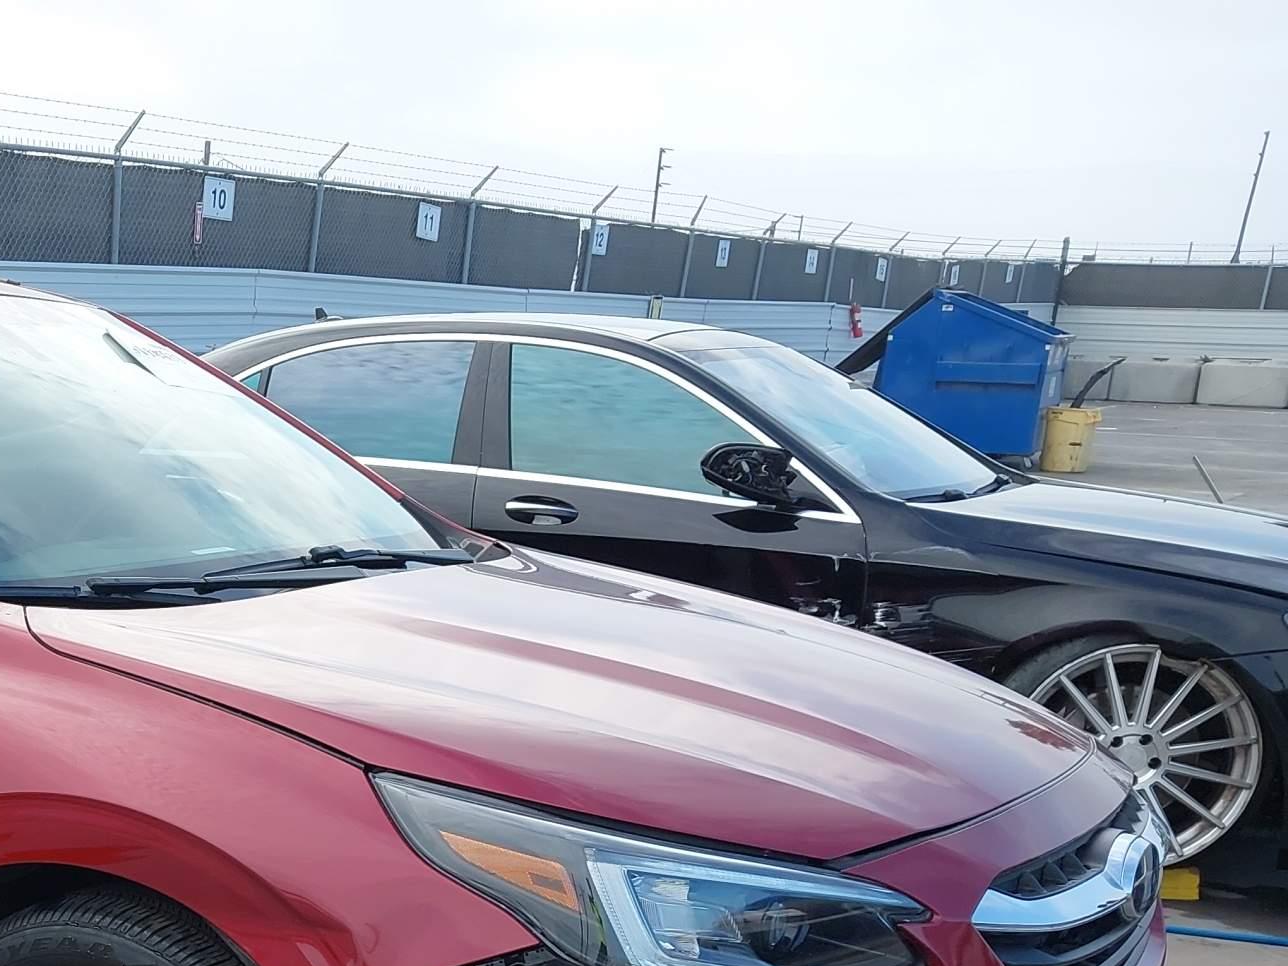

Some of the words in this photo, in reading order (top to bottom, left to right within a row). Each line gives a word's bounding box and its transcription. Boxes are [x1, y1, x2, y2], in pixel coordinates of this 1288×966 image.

[211, 187, 227, 210] 10
[423, 211, 435, 232] 11
[594, 231, 605, 248] 12
